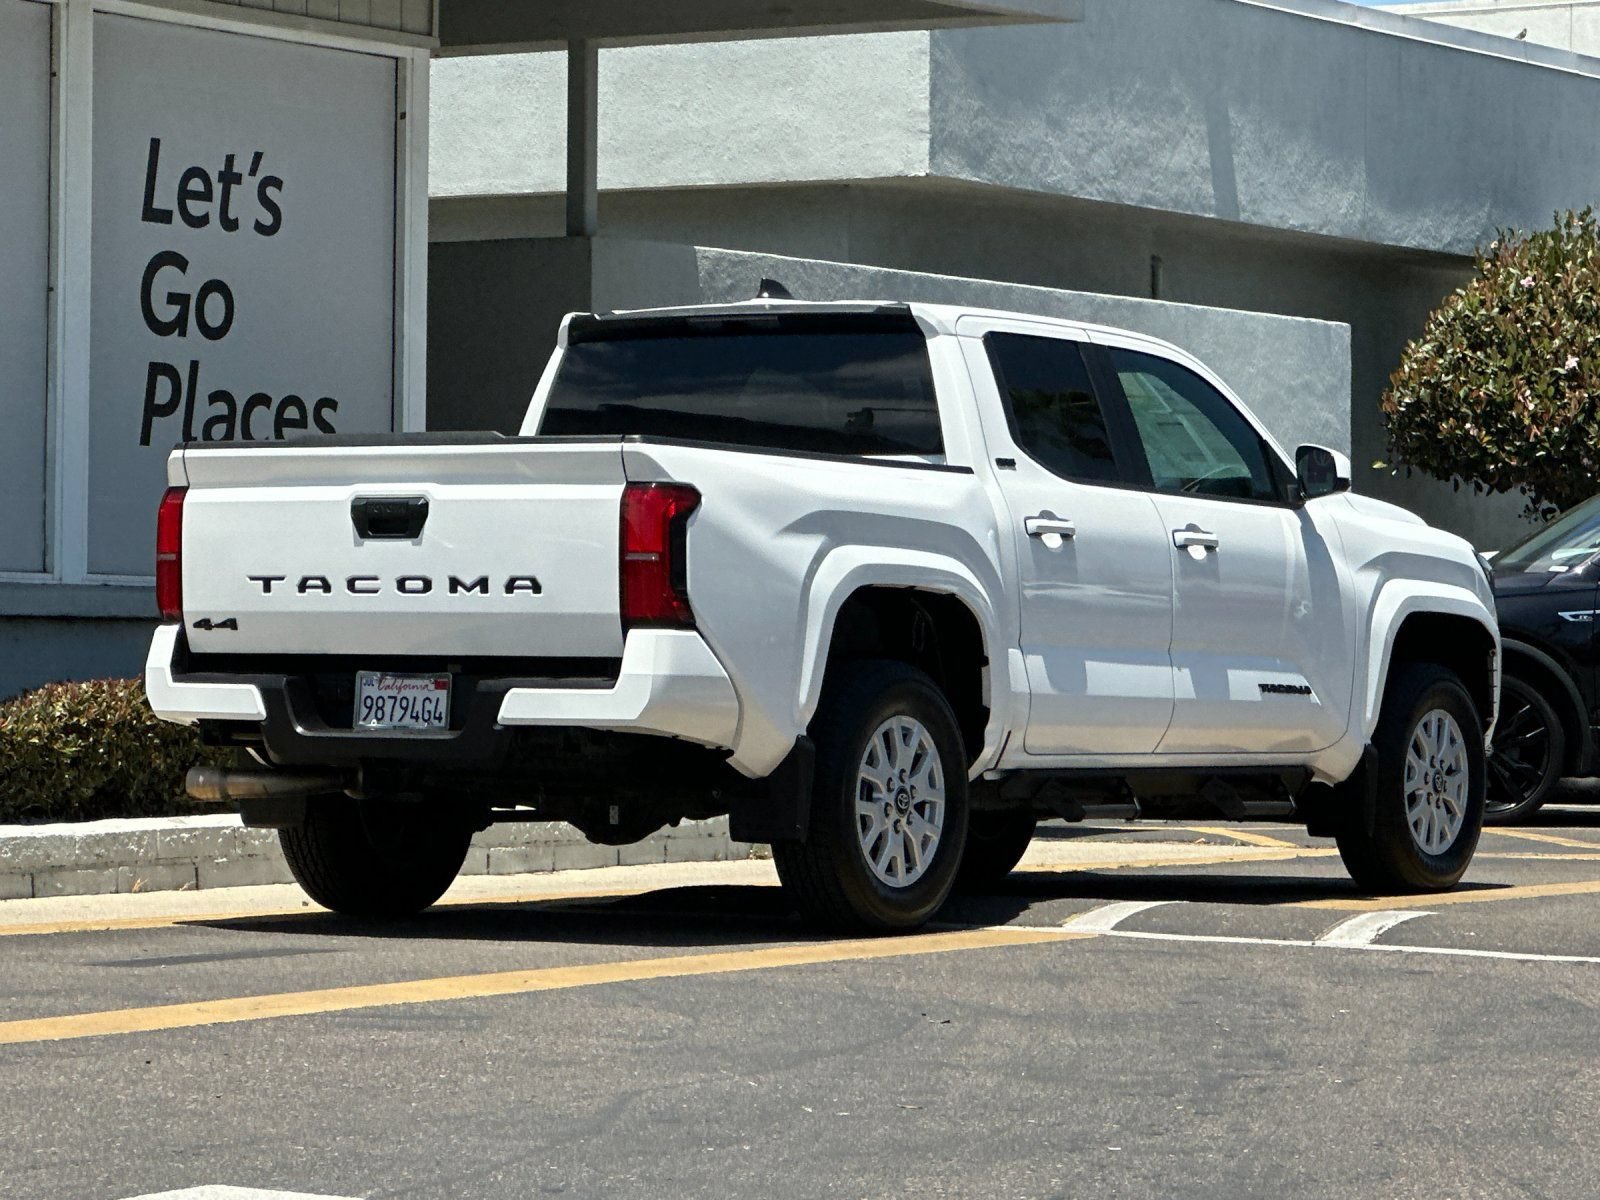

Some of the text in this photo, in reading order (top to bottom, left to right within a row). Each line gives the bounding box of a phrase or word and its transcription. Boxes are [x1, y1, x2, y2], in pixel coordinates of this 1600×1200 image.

[141, 137, 283, 237] Let's
[140, 250, 235, 341] Go
[139, 360, 339, 446] Places
[246, 575, 543, 595] TACOMA
[362, 695, 443, 723] 98794G4
[377, 678, 434, 694] California
